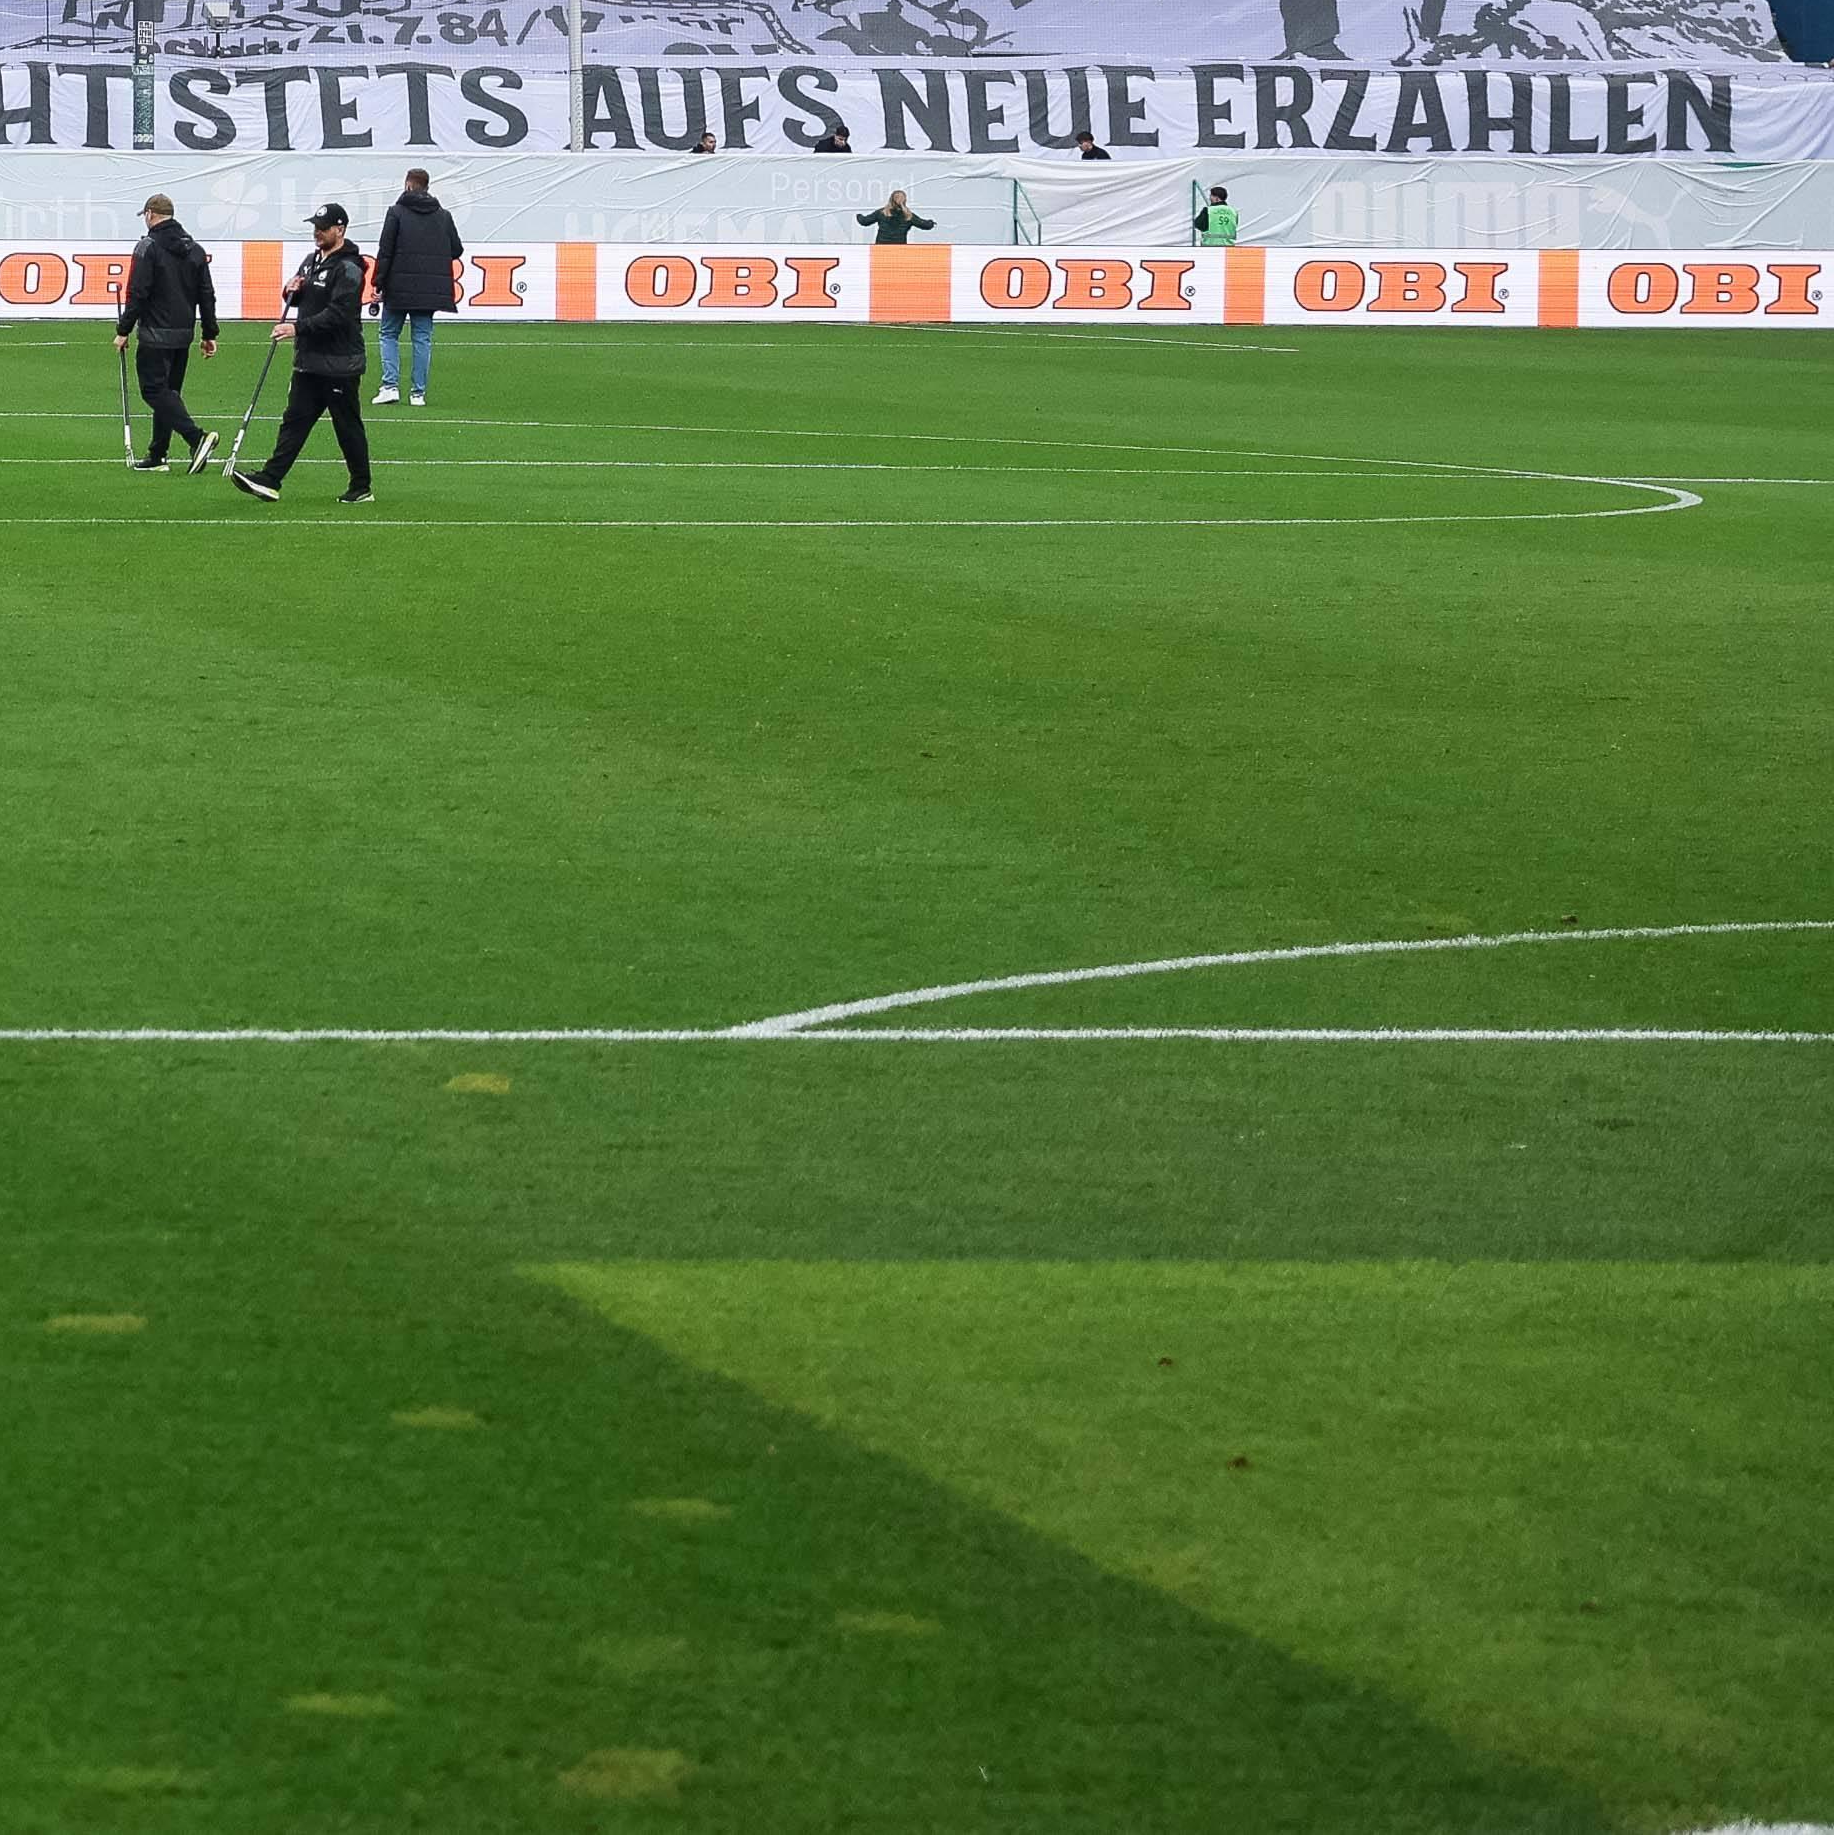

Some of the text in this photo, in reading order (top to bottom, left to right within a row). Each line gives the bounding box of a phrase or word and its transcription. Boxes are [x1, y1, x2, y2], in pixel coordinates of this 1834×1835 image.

[173, 63, 531, 151] STETS
[563, 64, 850, 151] AUFS
[878, 66, 1163, 155] NEUE
[624, 256, 840, 308] OBI
[979, 258, 1196, 310] OBI
[1293, 260, 1510, 313] OBI
[1607, 262, 1822, 315] OBI
